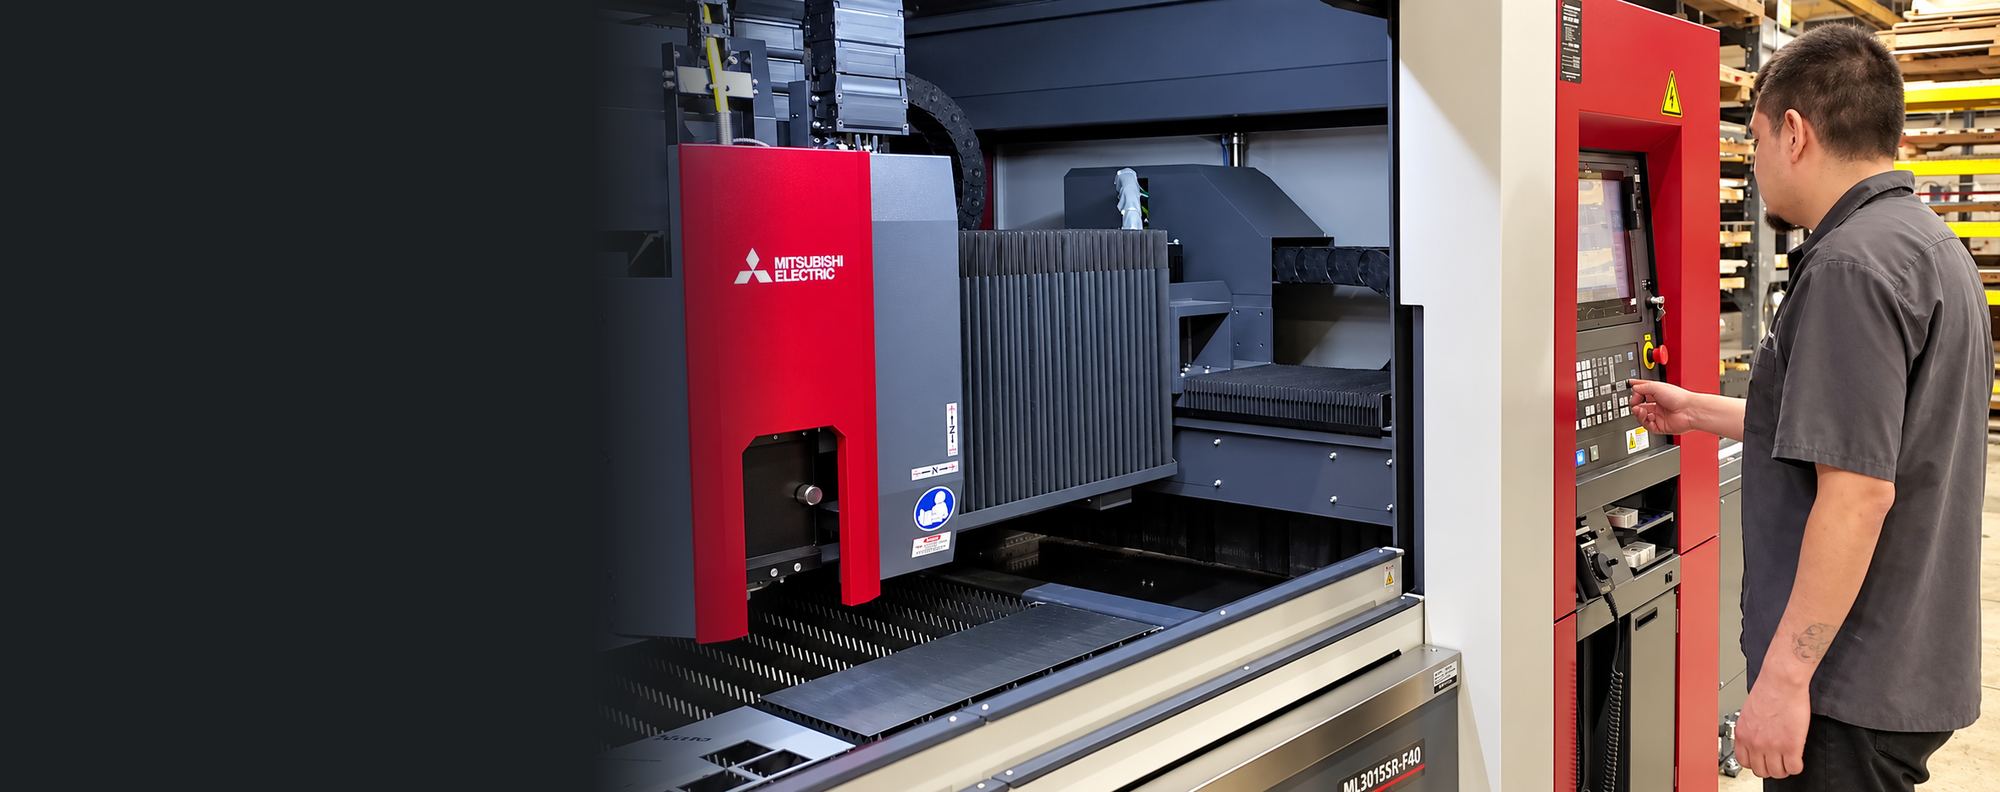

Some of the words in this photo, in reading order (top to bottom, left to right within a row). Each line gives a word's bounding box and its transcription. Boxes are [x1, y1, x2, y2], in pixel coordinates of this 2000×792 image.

[774, 255, 844, 269] MITSUBISHI
[774, 268, 835, 282] ELECTRIC
[1343, 746, 1421, 792] ML3015SR-F40
